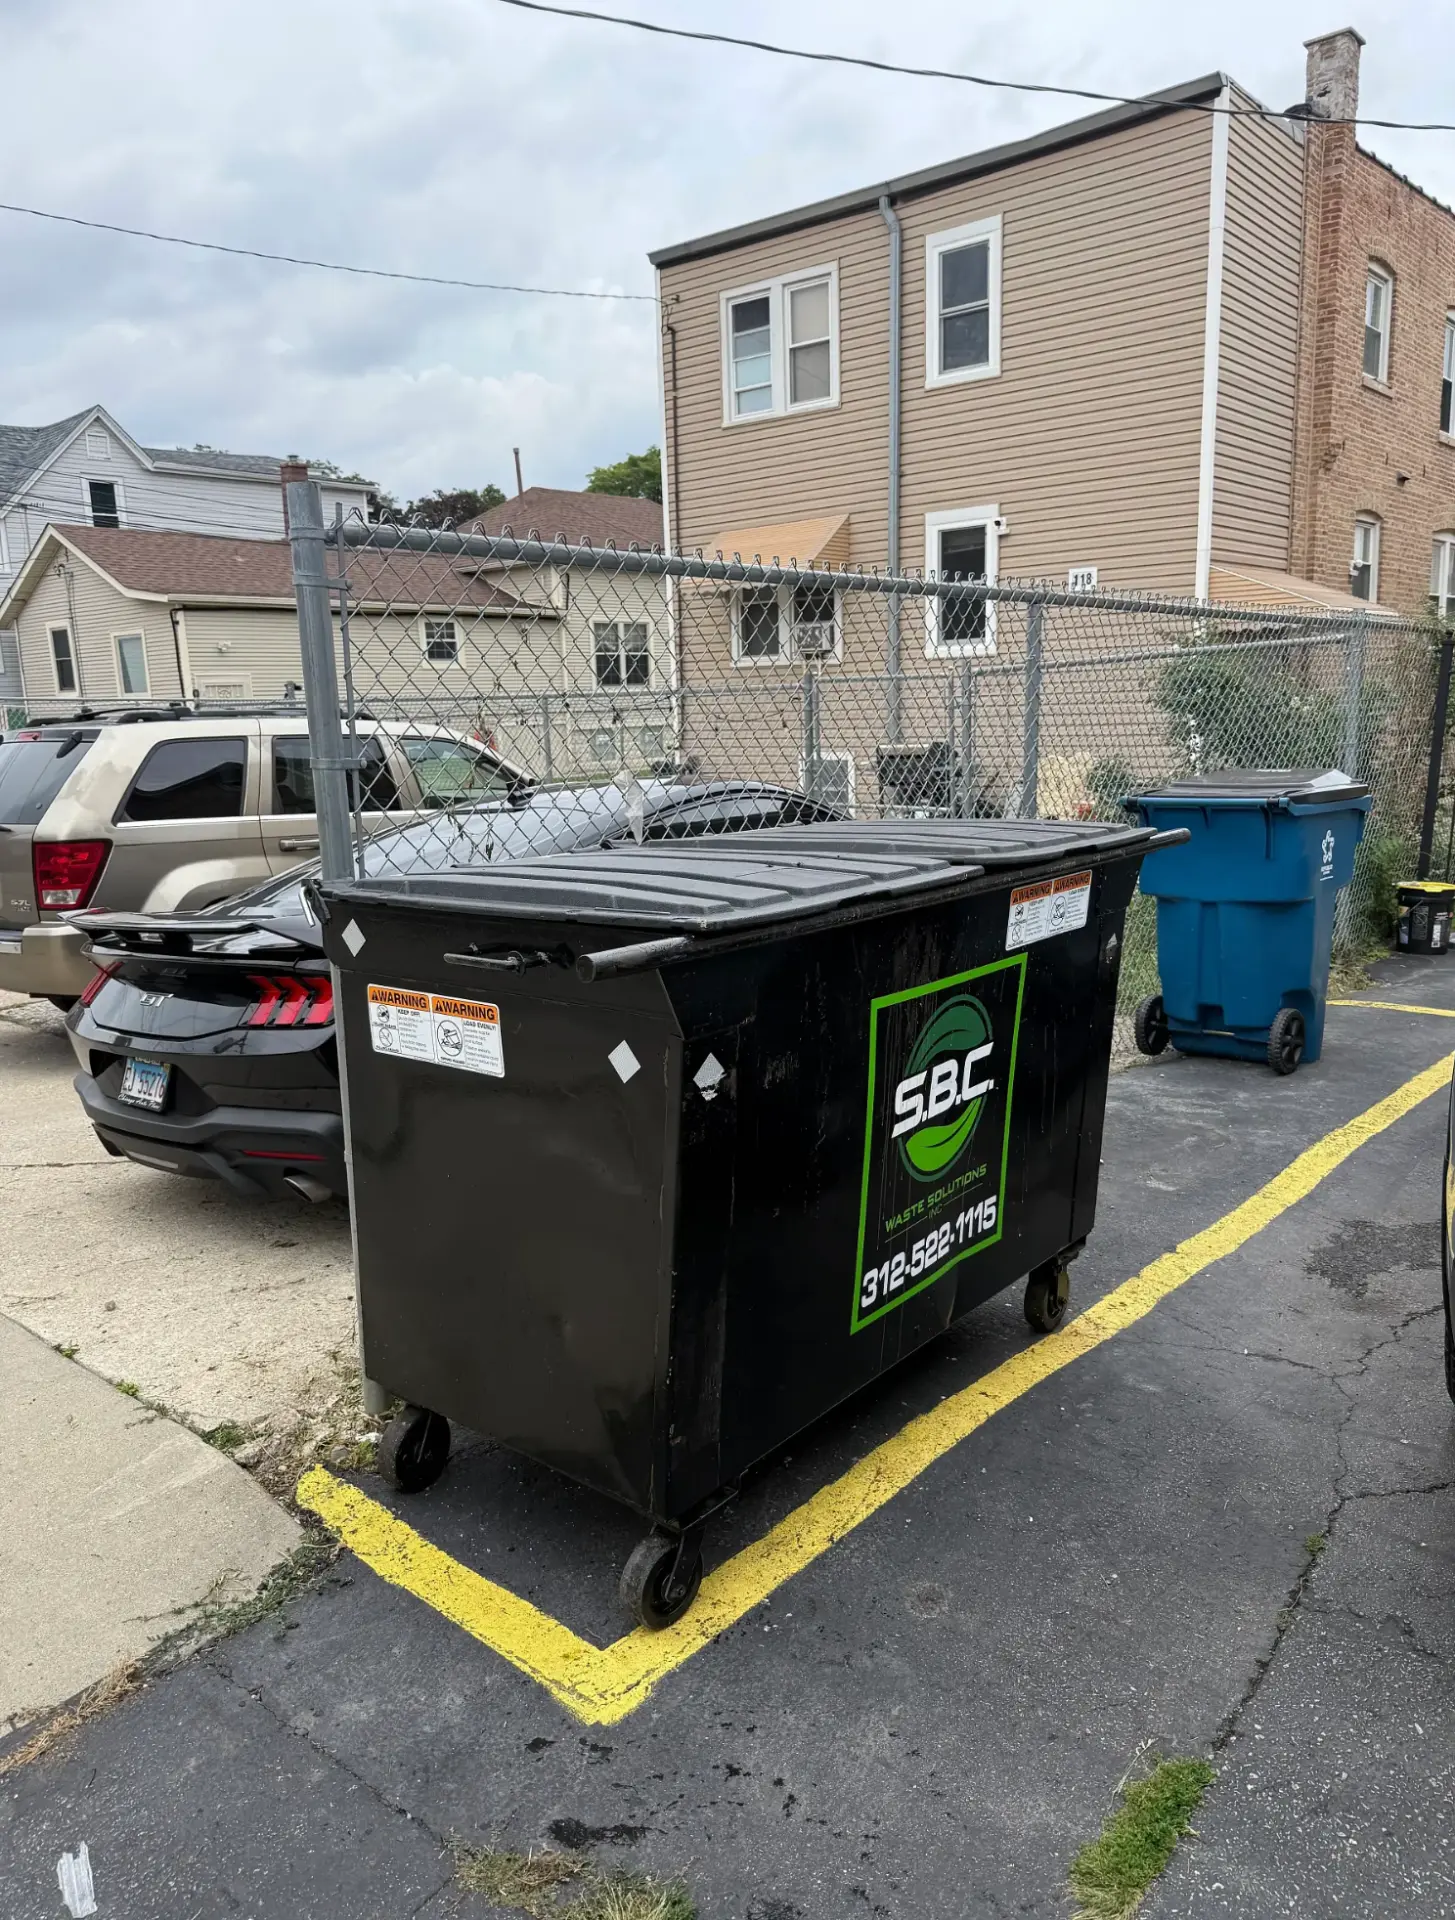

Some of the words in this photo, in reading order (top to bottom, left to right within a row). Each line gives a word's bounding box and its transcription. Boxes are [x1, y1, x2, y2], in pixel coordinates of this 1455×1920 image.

[1073, 572, 1092, 586] 118
[1020, 884, 1050, 900] WARNING
[140, 992, 174, 1007] GT
[378, 990, 427, 1008] WARNING
[442, 1000, 495, 1020] WARNING
[891, 1041, 995, 1138] S.B.C.
[885, 1199, 925, 1233] WASTE
[927, 1163, 988, 1208] SOLUTIONS
